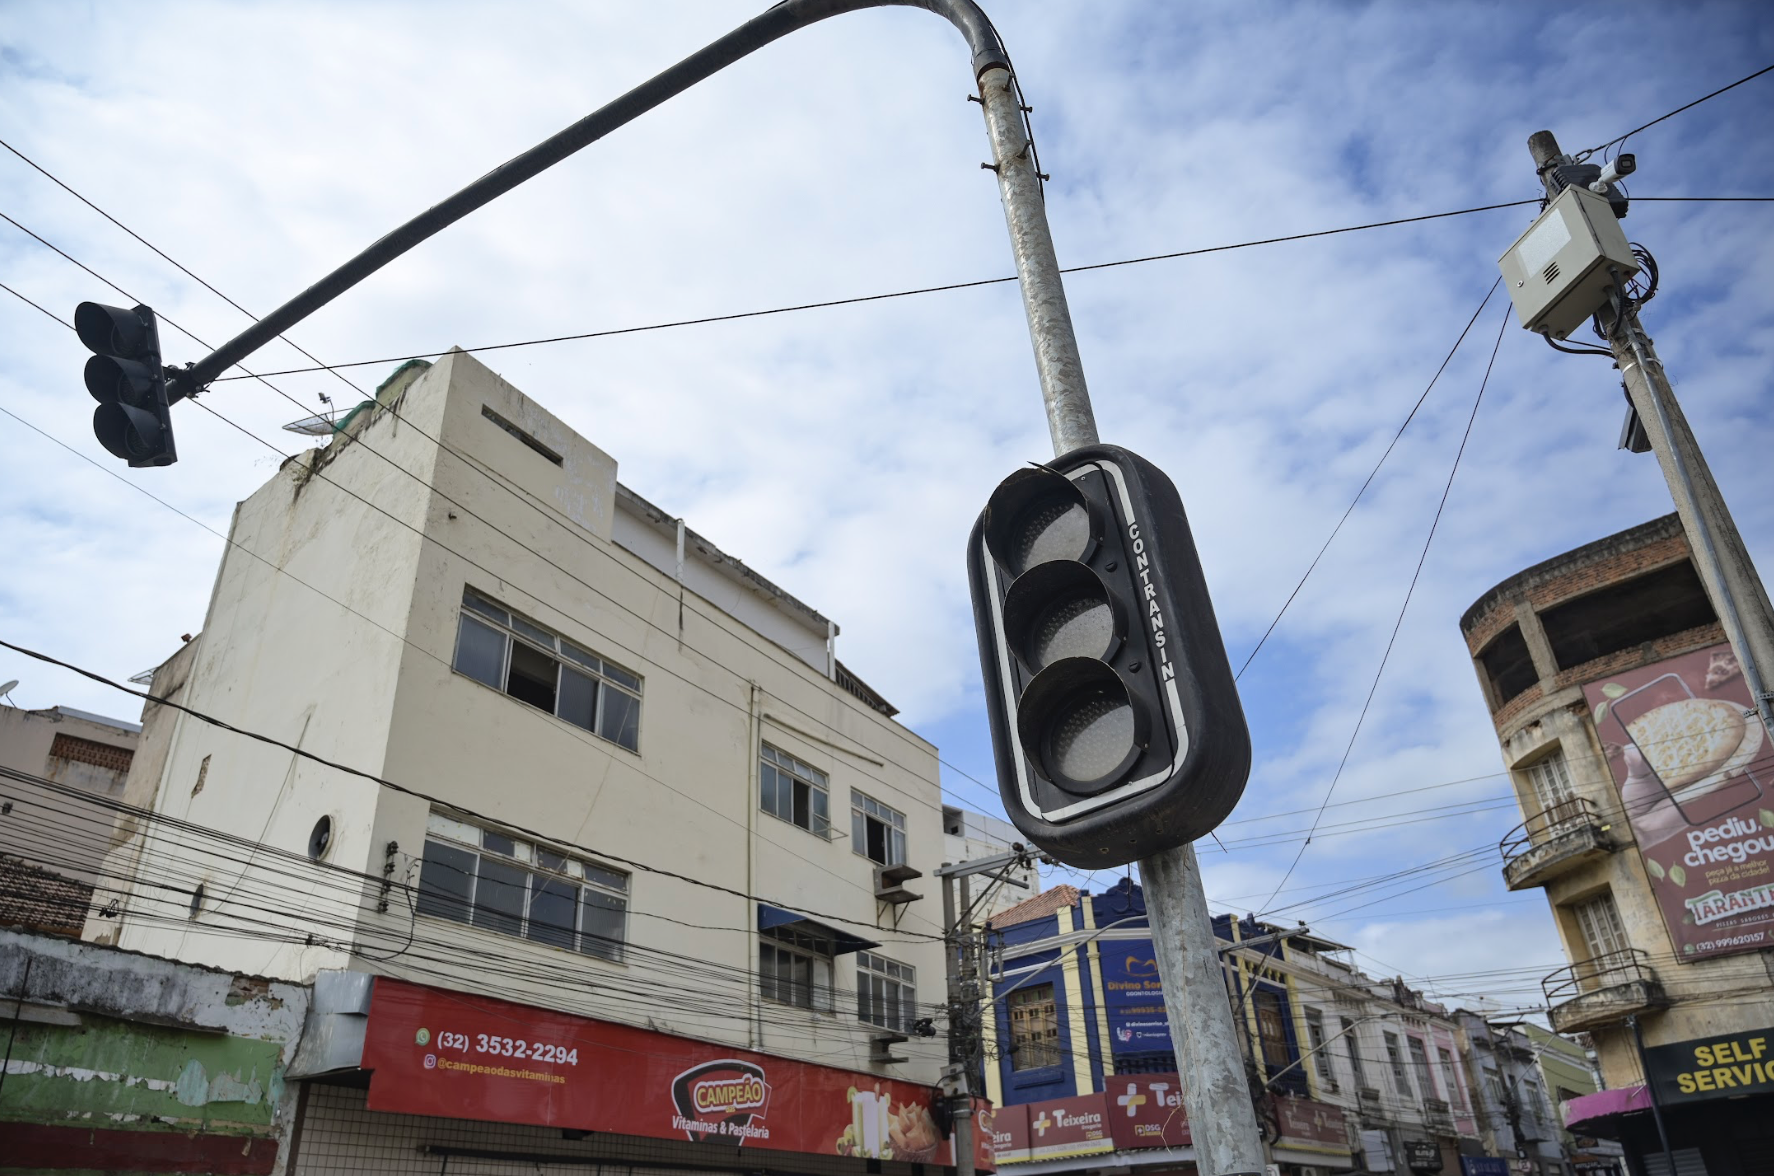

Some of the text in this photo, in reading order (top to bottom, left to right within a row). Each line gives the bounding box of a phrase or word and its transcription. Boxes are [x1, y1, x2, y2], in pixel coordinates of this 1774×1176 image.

[1128, 523, 1174, 680] CONTRANSIN
[1684, 835, 1774, 867] chegou
[1740, 859, 1767, 870] melhor
[1708, 875, 1729, 886] pizza
[1730, 872, 1740, 880] da
[1686, 885, 1774, 924] TARANT
[1696, 931, 1765, 953] (32) 999620157
[1107, 981, 1142, 991] Divino
[437, 1031, 579, 1066] (32) 3532-2294
[1694, 1037, 1767, 1067] SELF
[437, 1057, 566, 1084] @campeaodasvitaminas
[697, 1079, 762, 1106] CAMPEÃO
[672, 1115, 770, 1139] Vitaminas & Pastelaria
[1052, 1109, 1102, 1128] Teixeira
